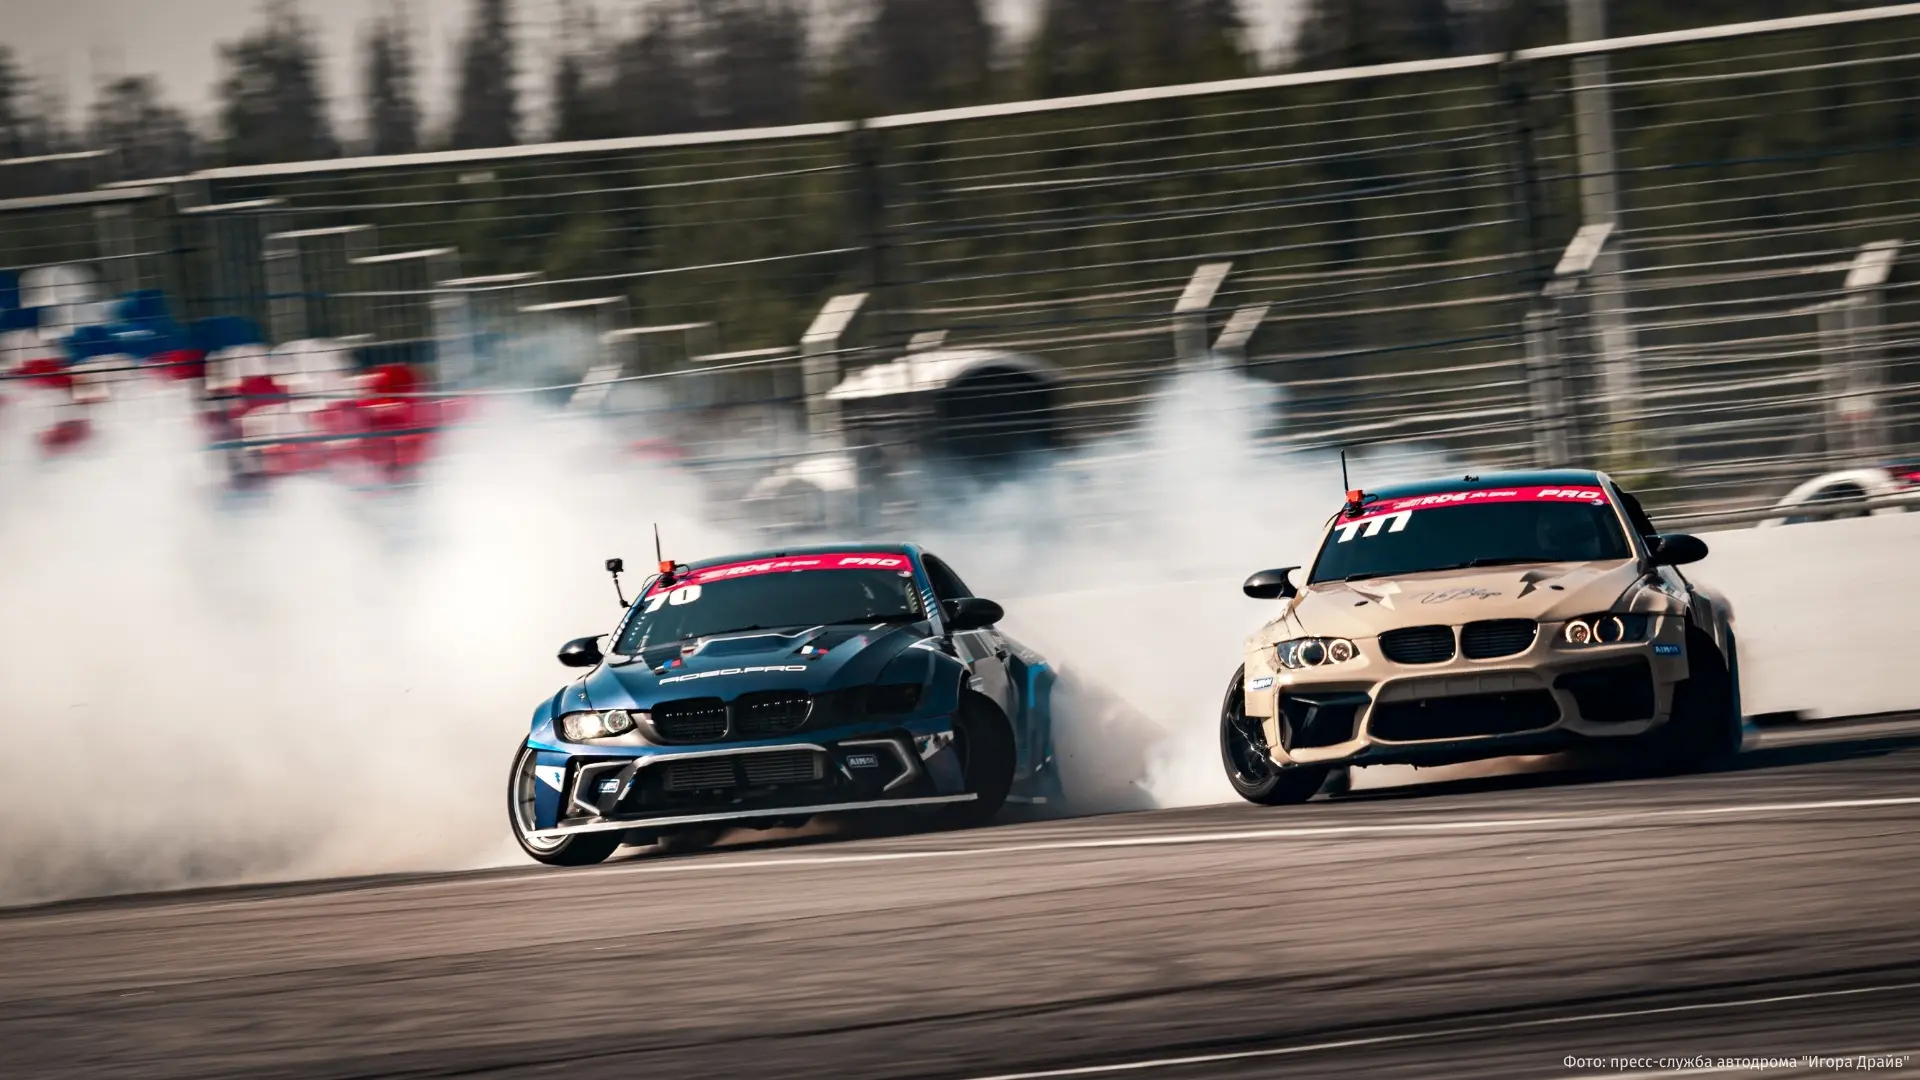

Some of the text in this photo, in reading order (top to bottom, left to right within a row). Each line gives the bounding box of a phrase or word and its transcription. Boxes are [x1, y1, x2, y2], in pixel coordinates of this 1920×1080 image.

[1536, 488, 1601, 499] PRO
[1334, 509, 1413, 544] 777
[837, 556, 902, 567] PRO
[643, 584, 702, 615] 70
